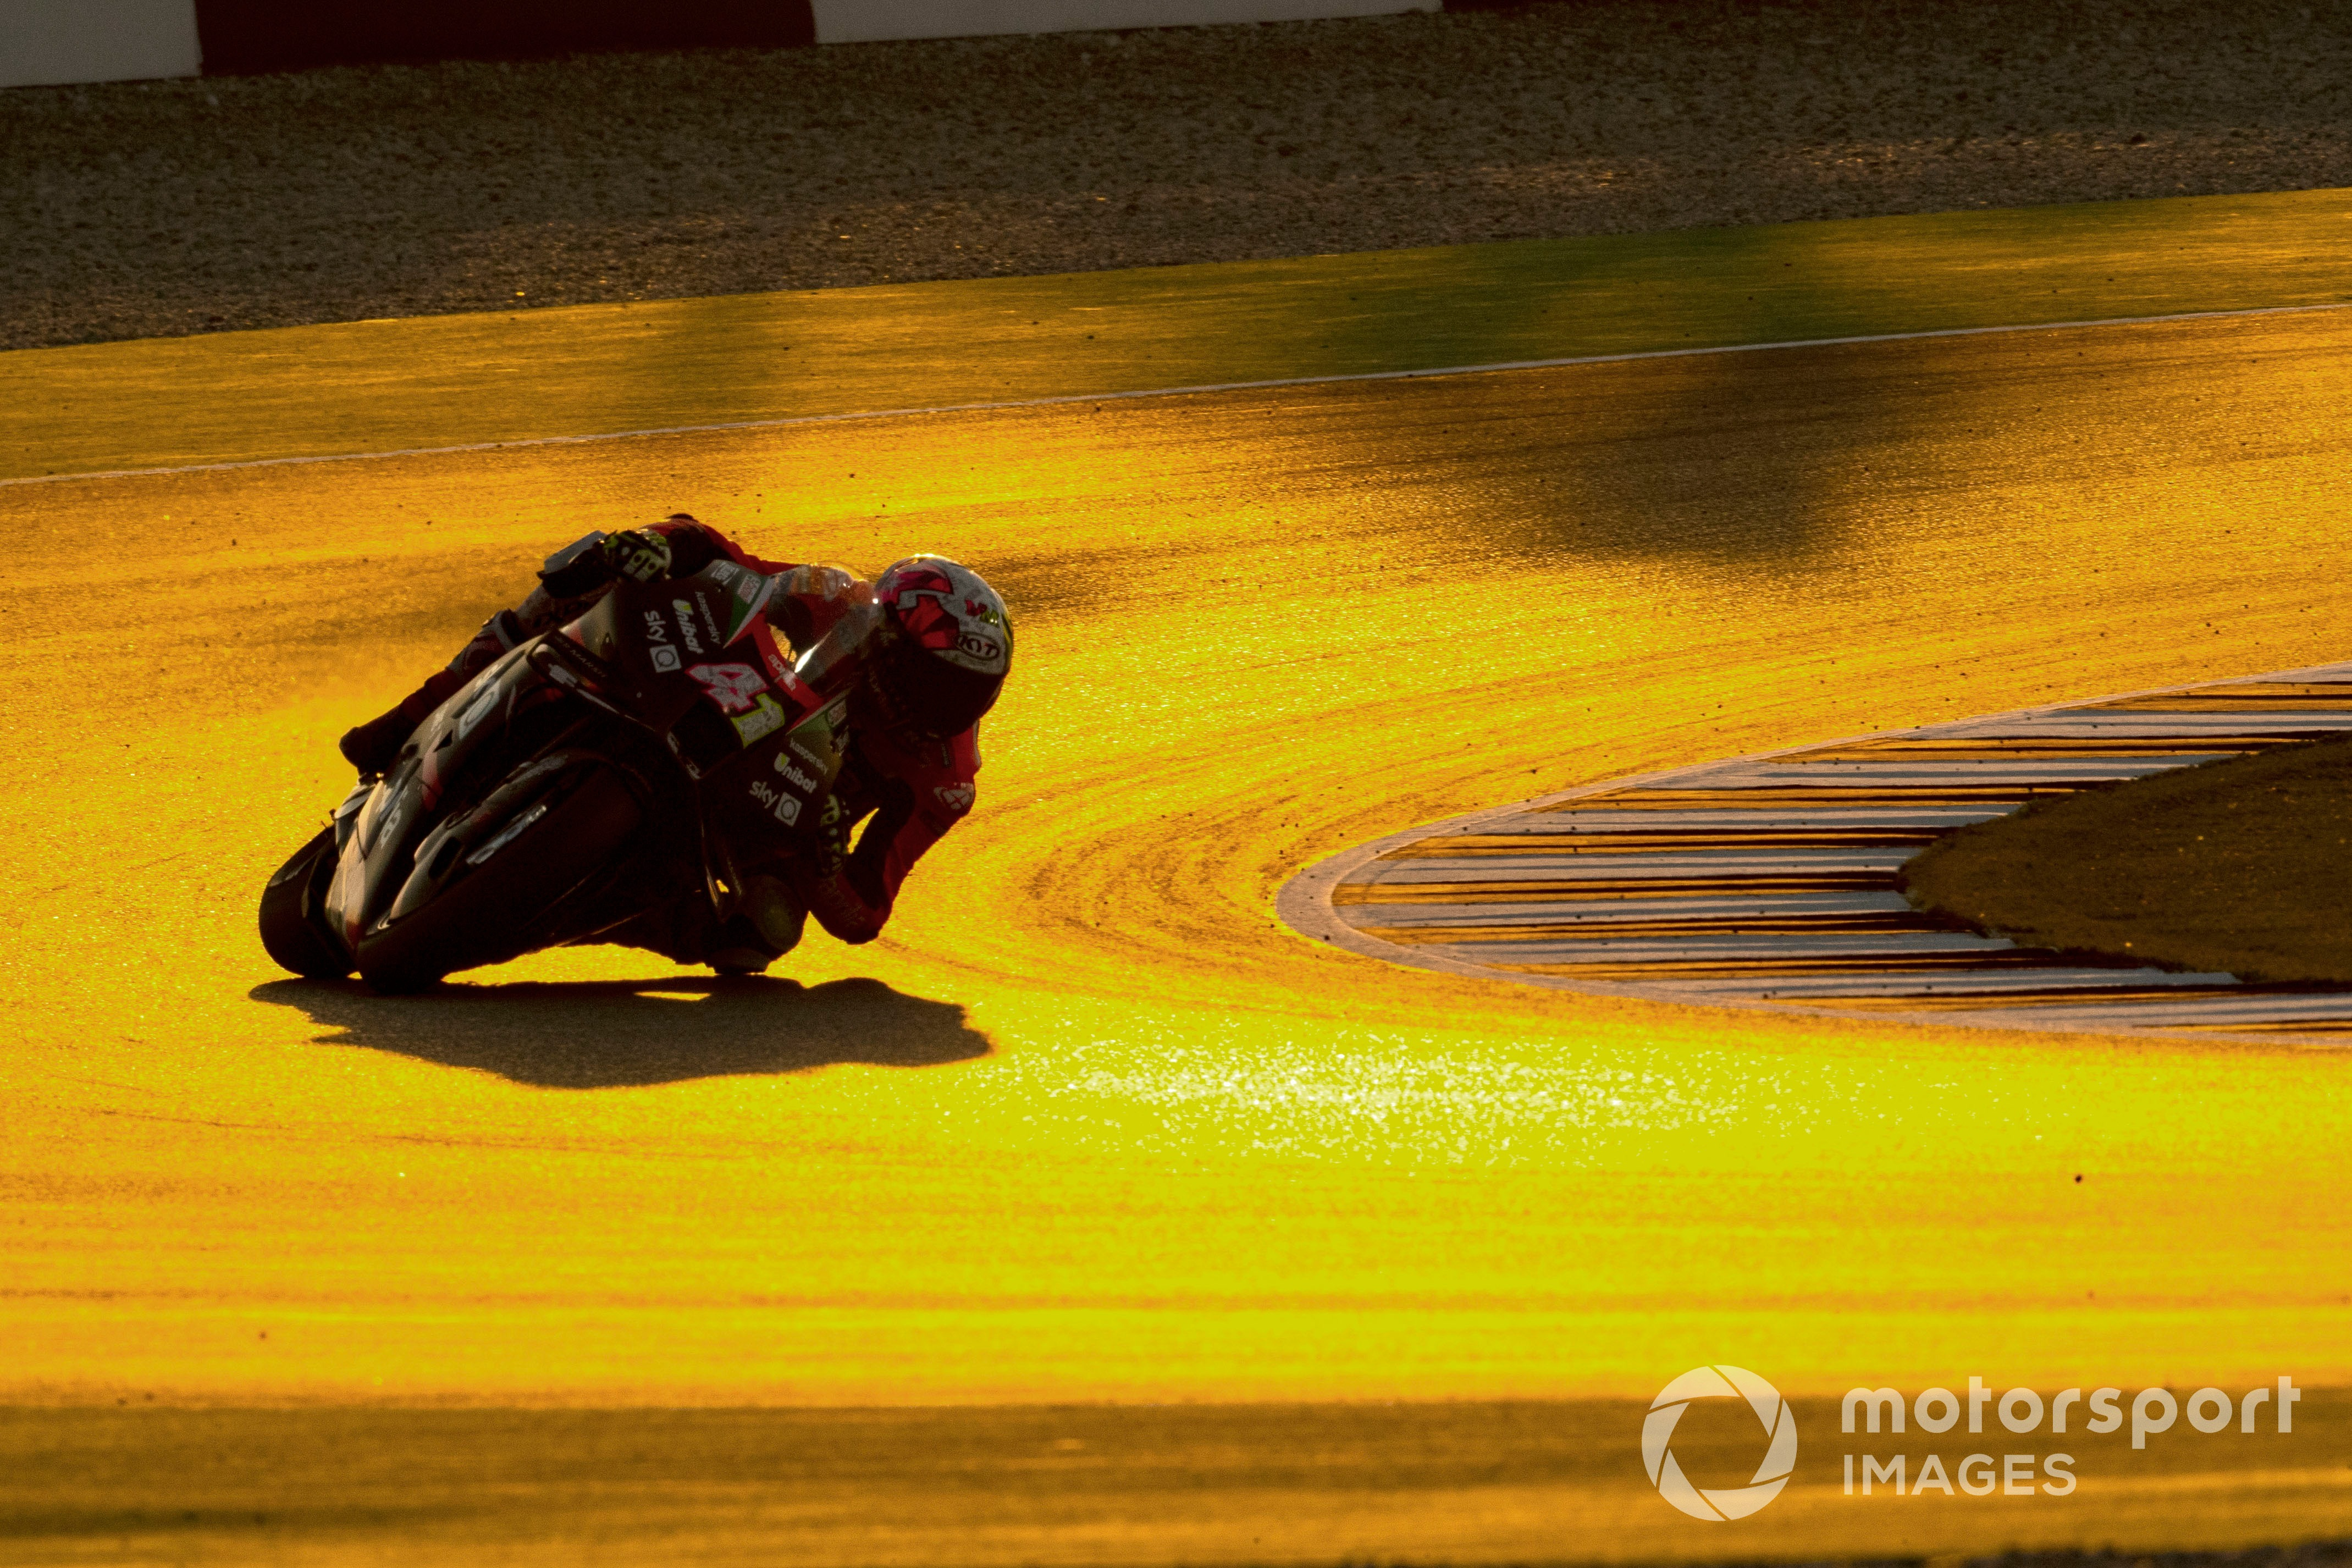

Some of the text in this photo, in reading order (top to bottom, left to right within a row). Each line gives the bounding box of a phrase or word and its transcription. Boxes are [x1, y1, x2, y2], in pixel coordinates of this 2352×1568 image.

[644, 610, 667, 643] sky
[684, 661, 786, 749] 41
[748, 780, 779, 809] sky
